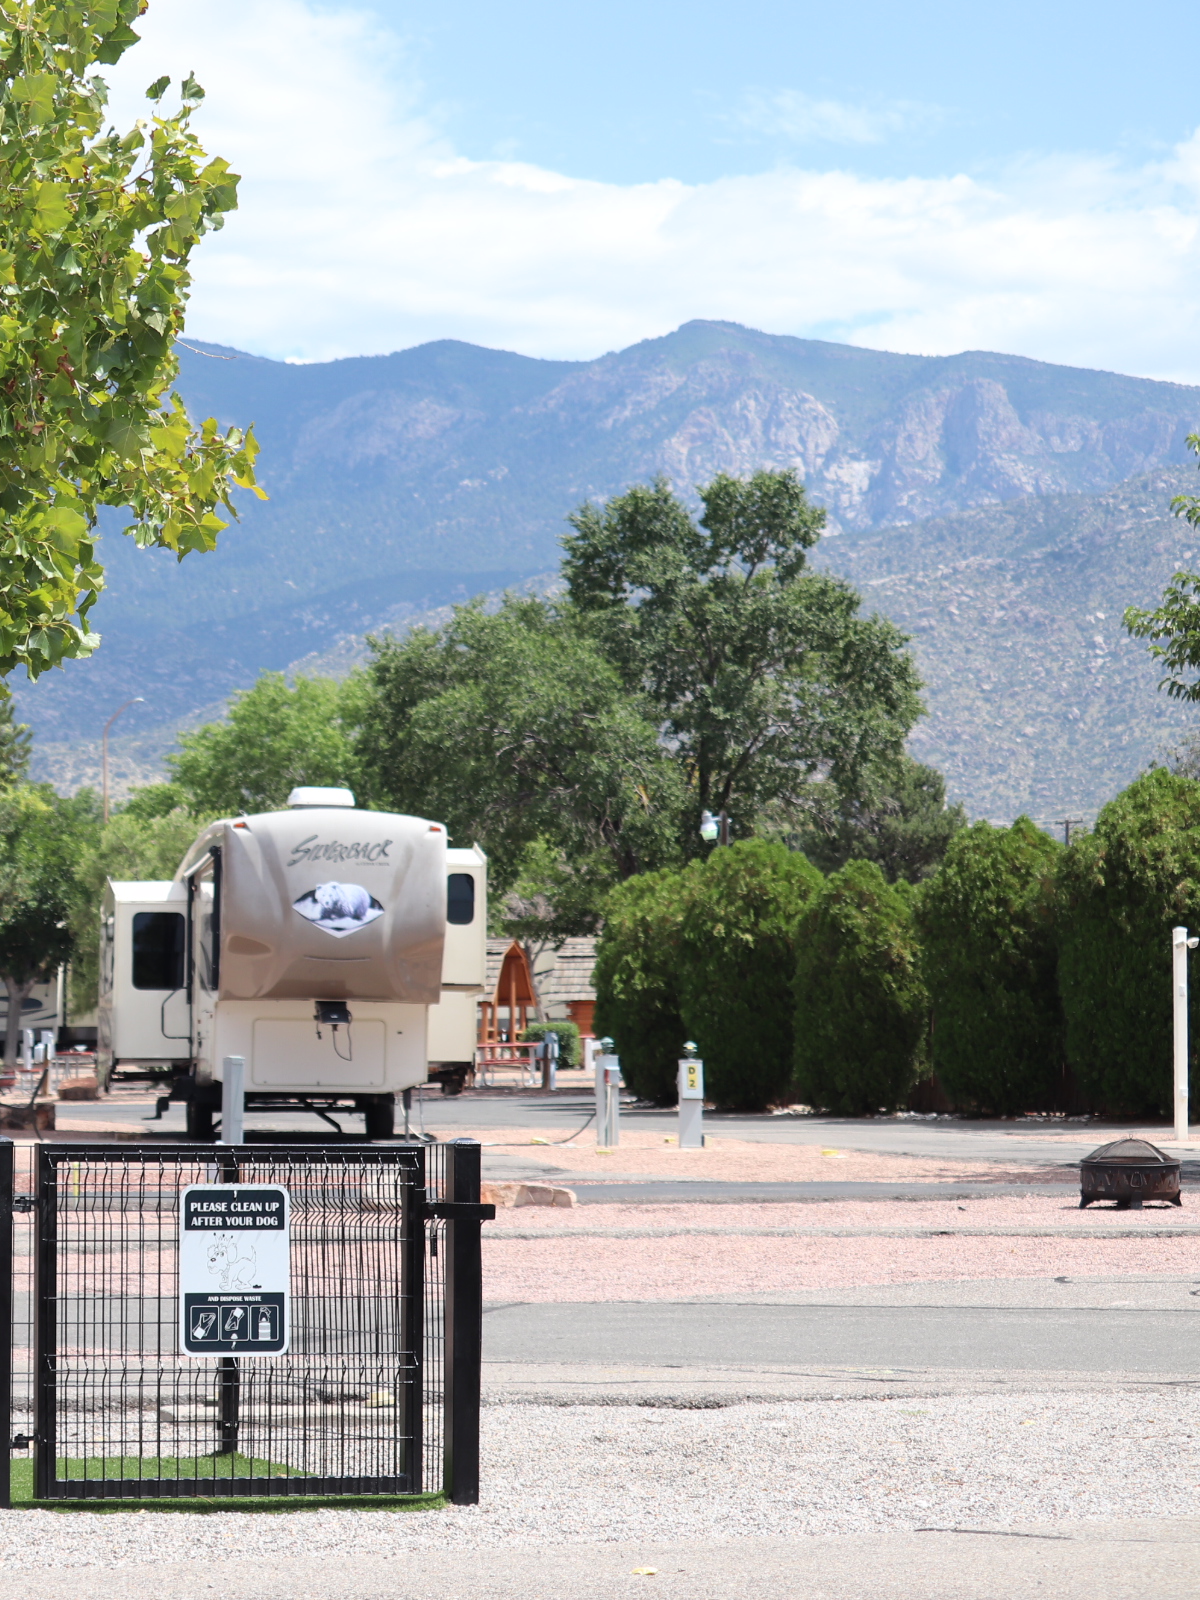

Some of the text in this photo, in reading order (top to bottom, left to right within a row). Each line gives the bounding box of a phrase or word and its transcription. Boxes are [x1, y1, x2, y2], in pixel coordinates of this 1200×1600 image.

[287, 834, 393, 867] SILVERBACK
[190, 1202, 280, 1212] PLEASE CLEAN UP
[191, 1217, 278, 1226] AFTER YOUR DOG
